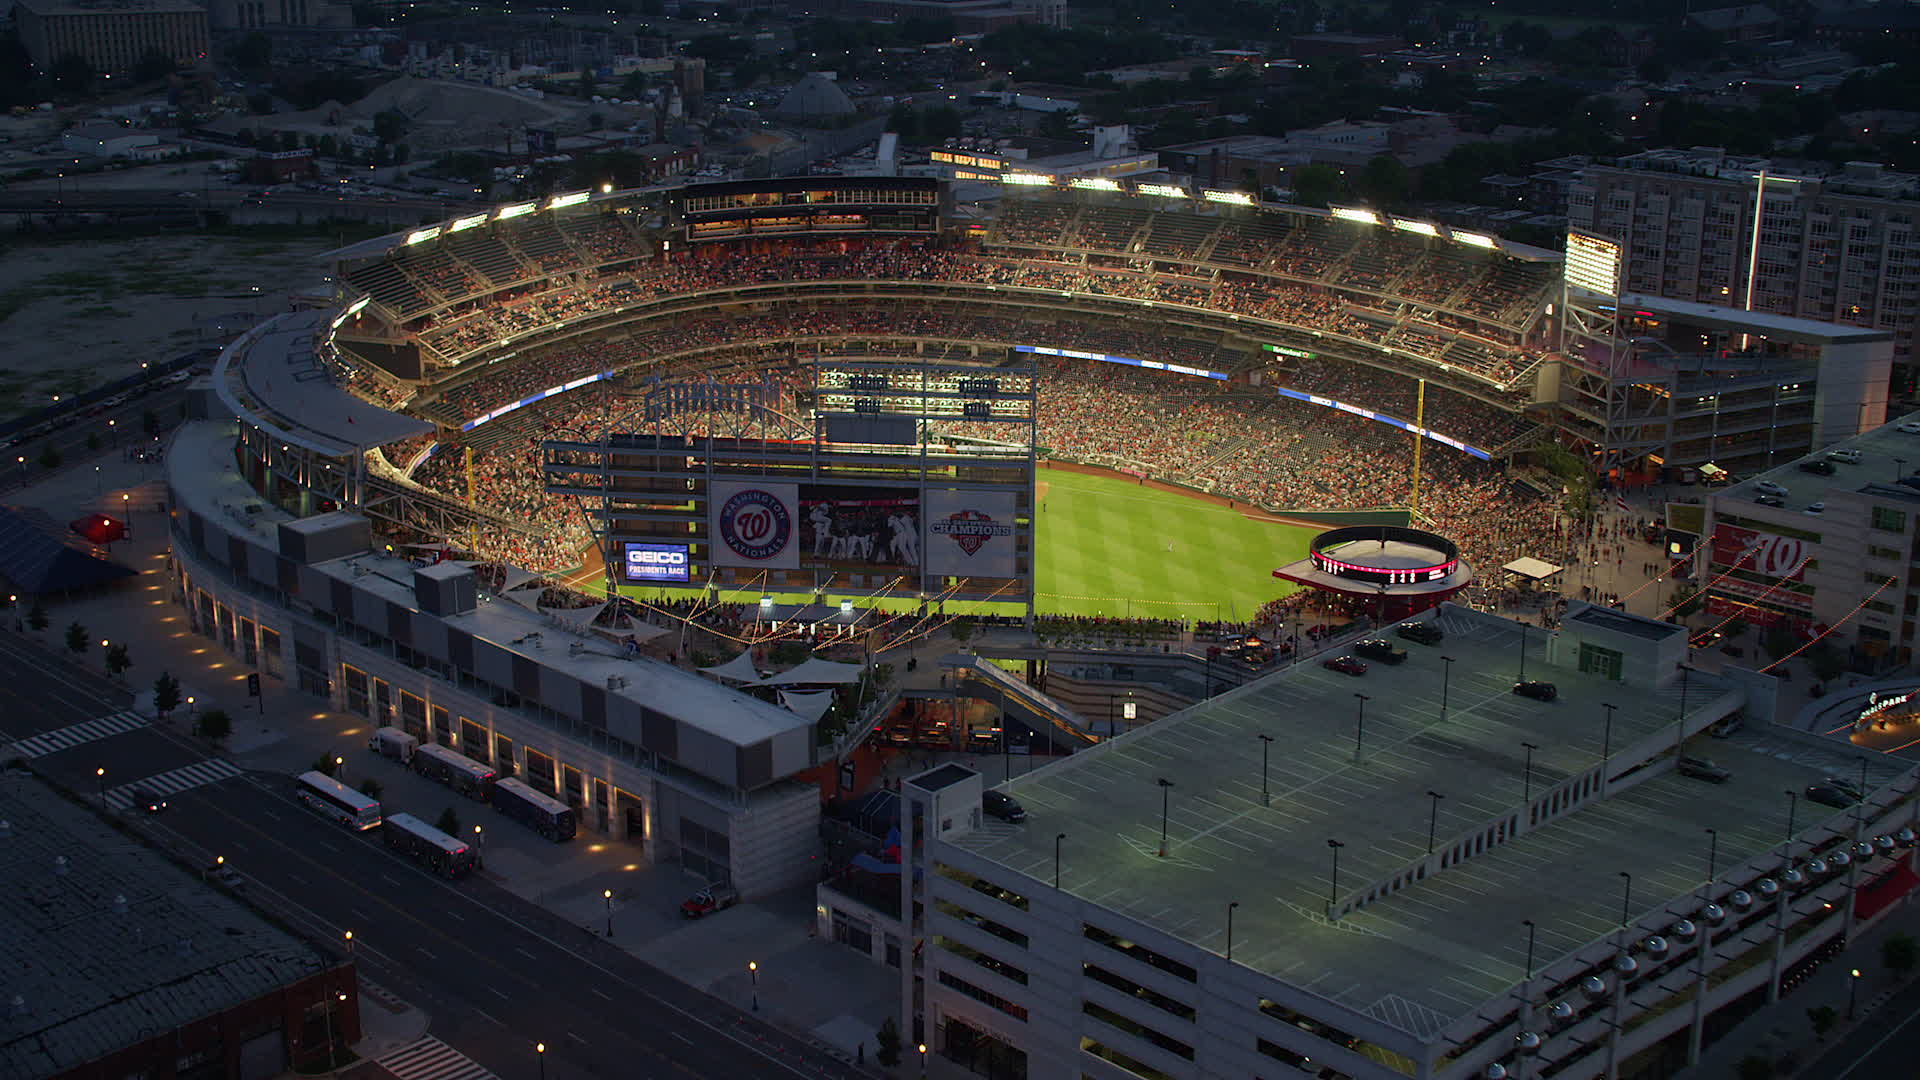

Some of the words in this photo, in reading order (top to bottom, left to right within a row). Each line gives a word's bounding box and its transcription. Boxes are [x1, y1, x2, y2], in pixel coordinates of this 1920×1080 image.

[725, 491, 787, 519] WASHINGTON
[738, 509, 771, 541] W
[930, 524, 1010, 536] CHAMPIONS
[728, 536, 784, 556] NATIONALS
[629, 550, 684, 564] GEICO
[629, 565, 667, 574] PRESIDENTS
[668, 567, 685, 575] RACE
[1882, 695, 1907, 708] PARK
